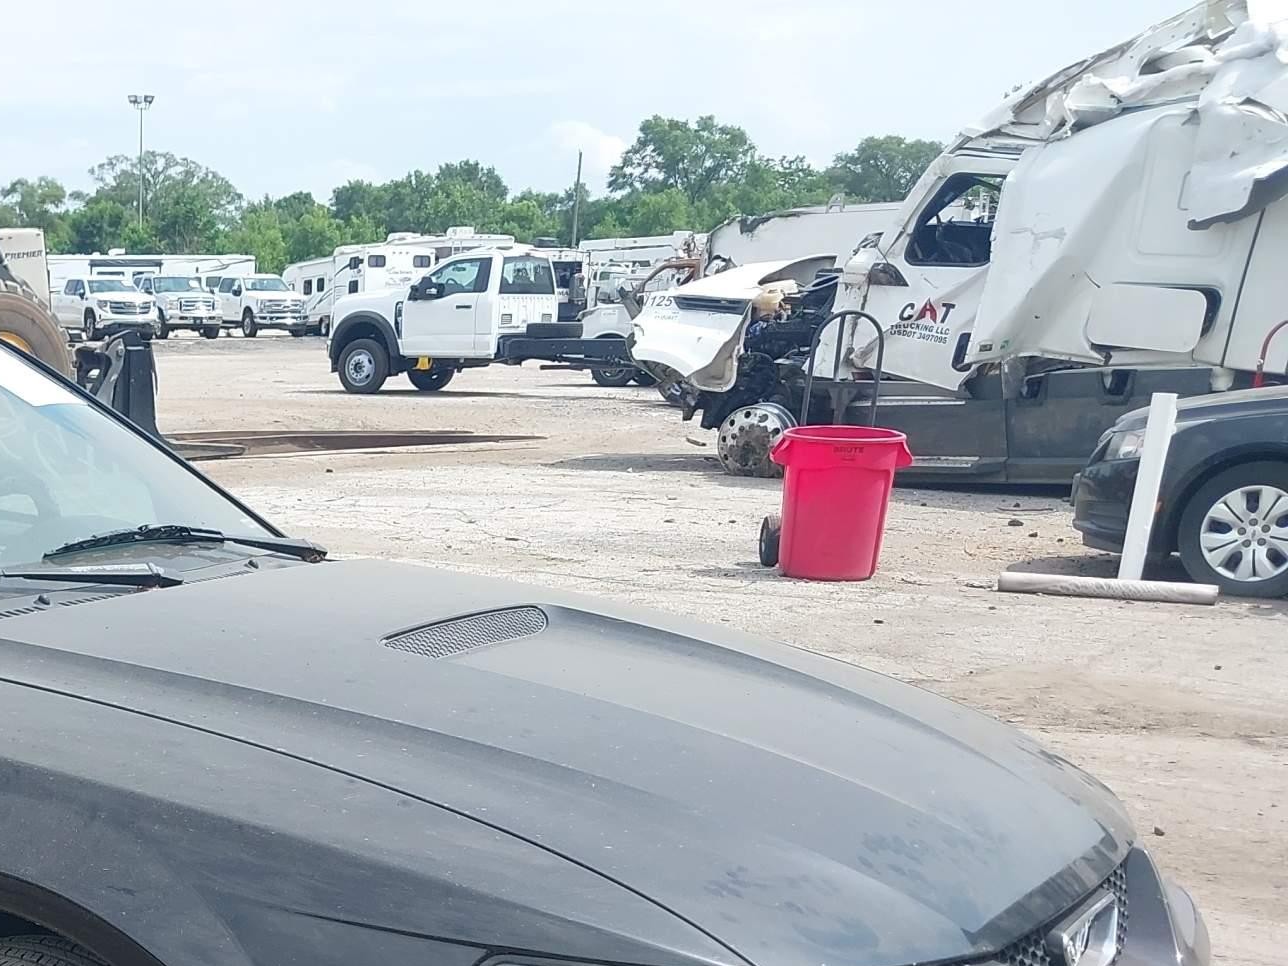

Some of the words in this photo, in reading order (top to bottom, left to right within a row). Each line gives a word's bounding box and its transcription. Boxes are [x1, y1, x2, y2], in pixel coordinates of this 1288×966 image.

[4, 249, 44, 260] PREMIER
[898, 297, 956, 325] CAT
[889, 329, 916, 339] USDOT
[890, 322, 934, 333] TRUCKING
[935, 326, 950, 336] LLC
